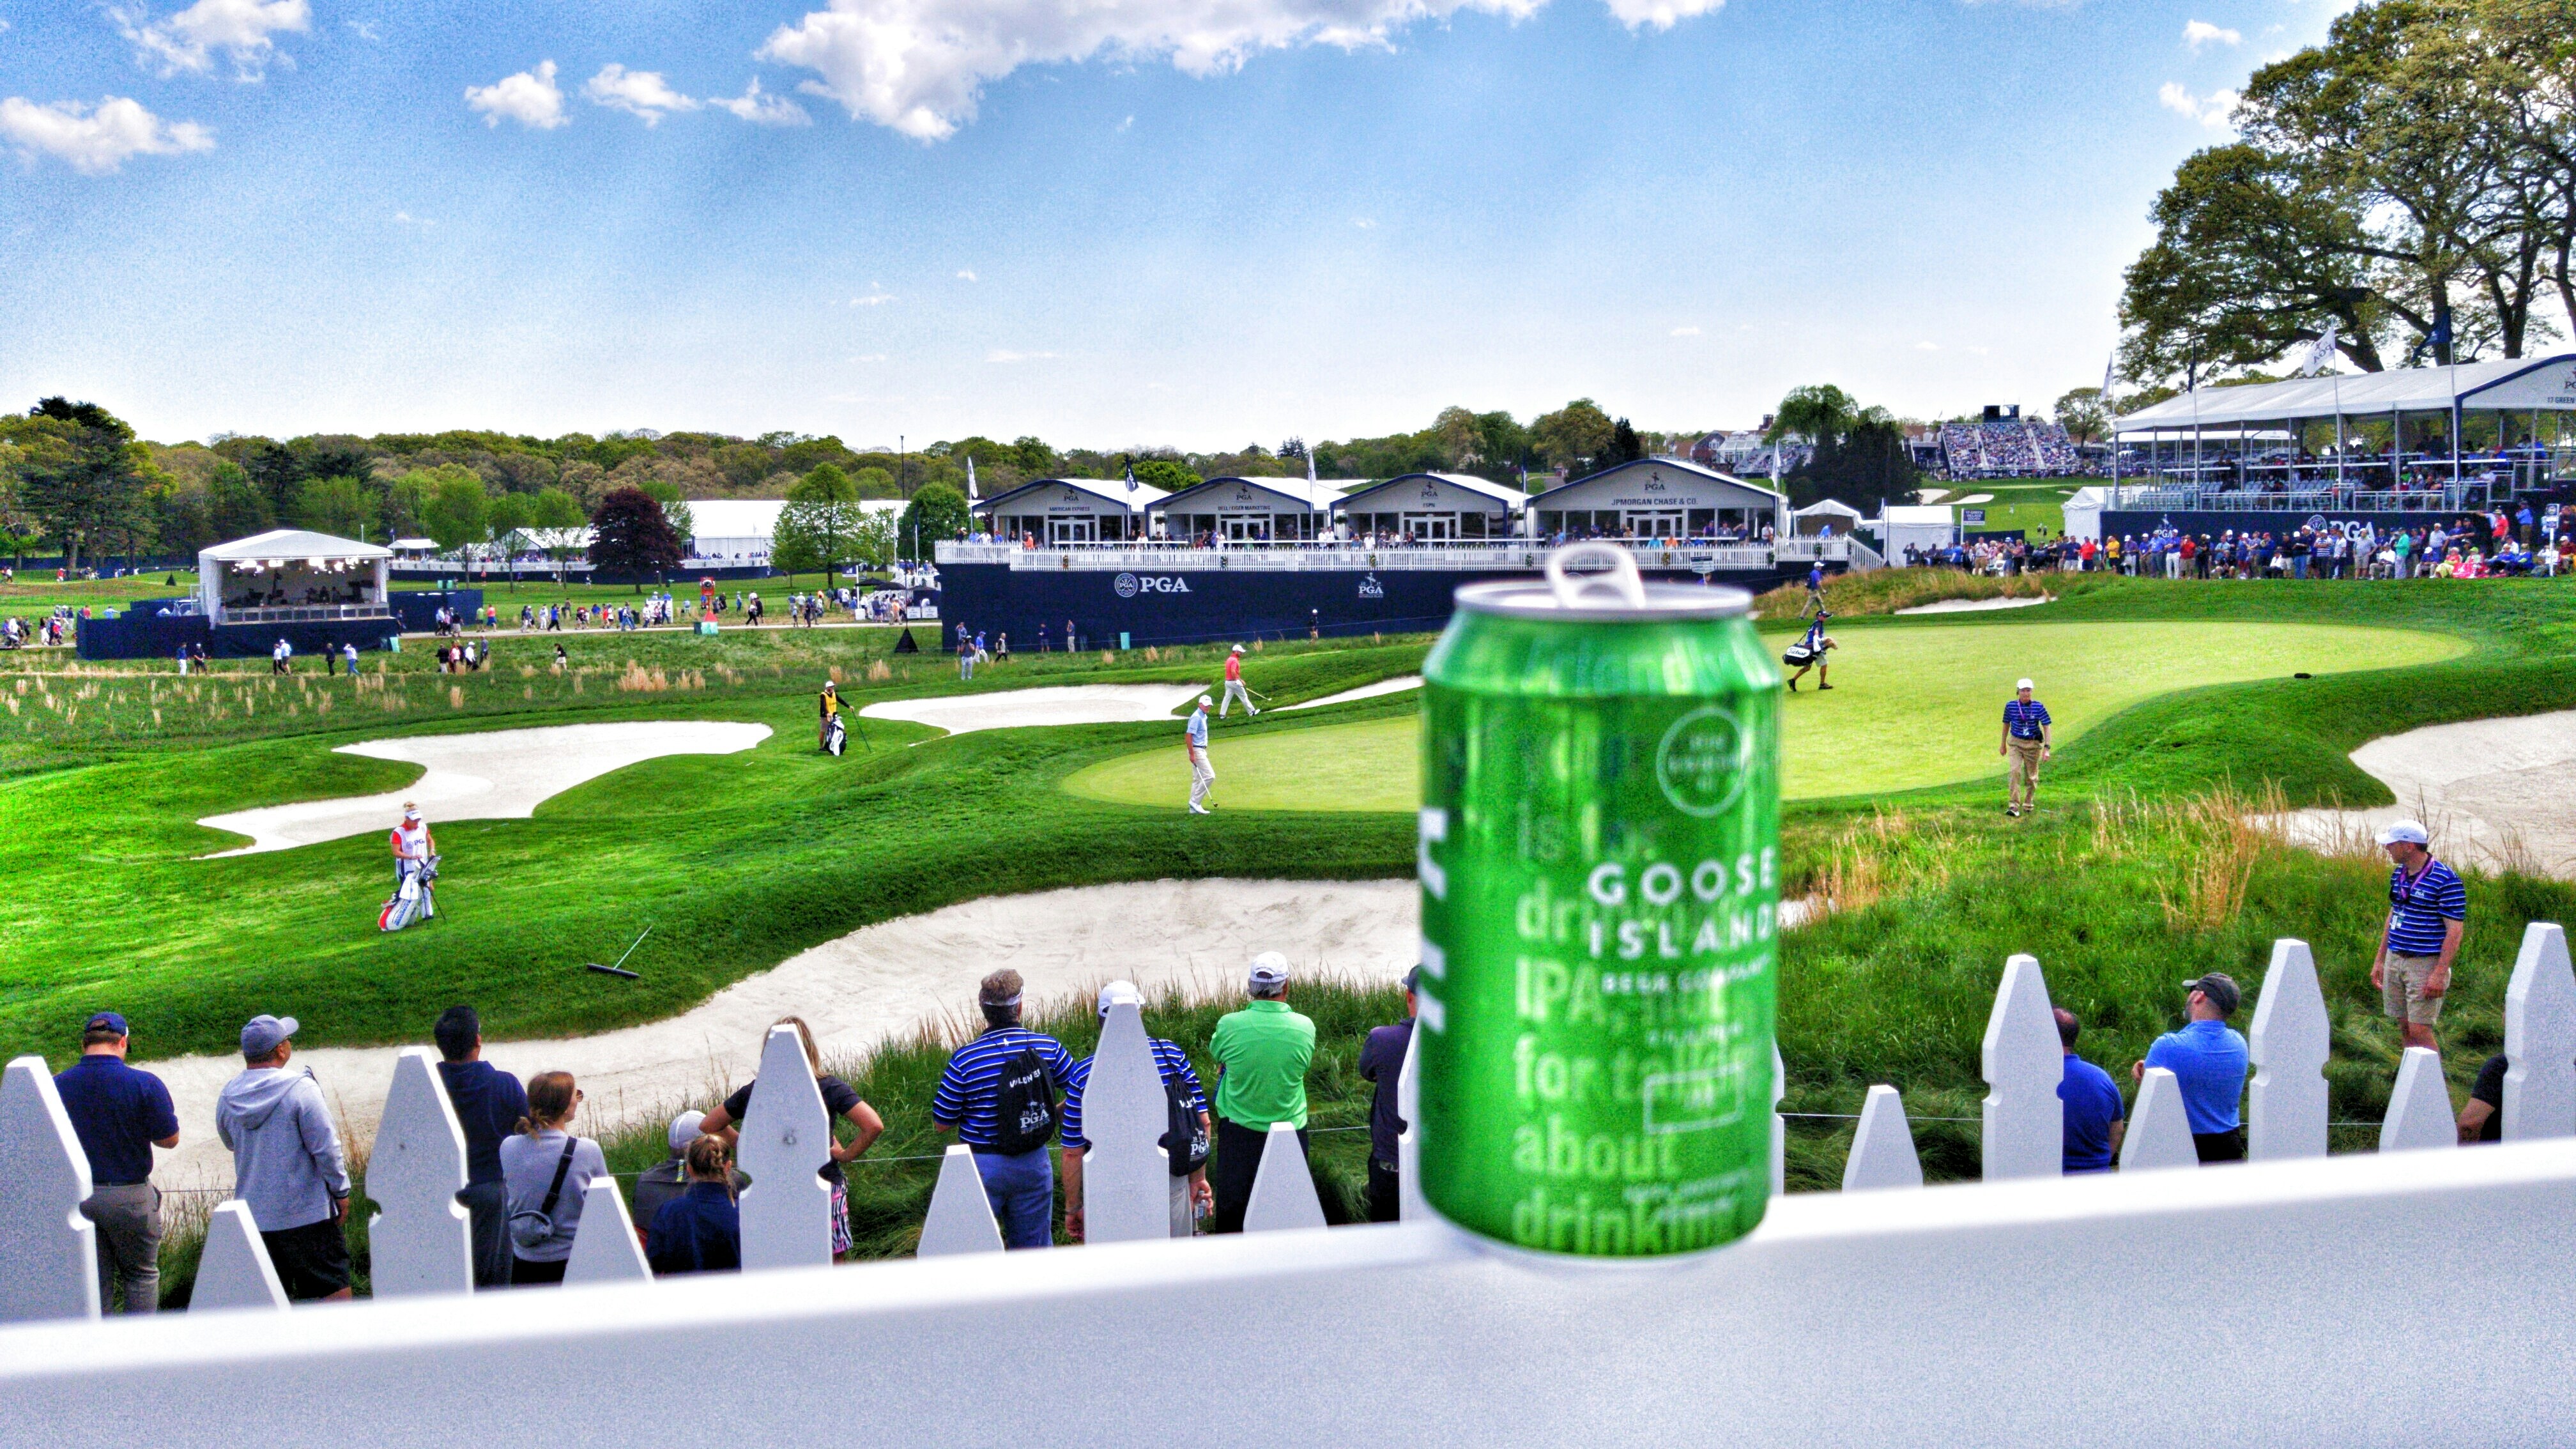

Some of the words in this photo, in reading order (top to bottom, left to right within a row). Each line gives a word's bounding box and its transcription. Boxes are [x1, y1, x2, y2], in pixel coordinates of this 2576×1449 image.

[1139, 577, 1190, 593] PGA
[1358, 586, 1384, 594] PGA
[1587, 846, 1777, 907] GOOSE
[1588, 901, 1774, 960] ISLAND
[1020, 1109, 1050, 1129] PGA
[1512, 1113, 1682, 1179] about
